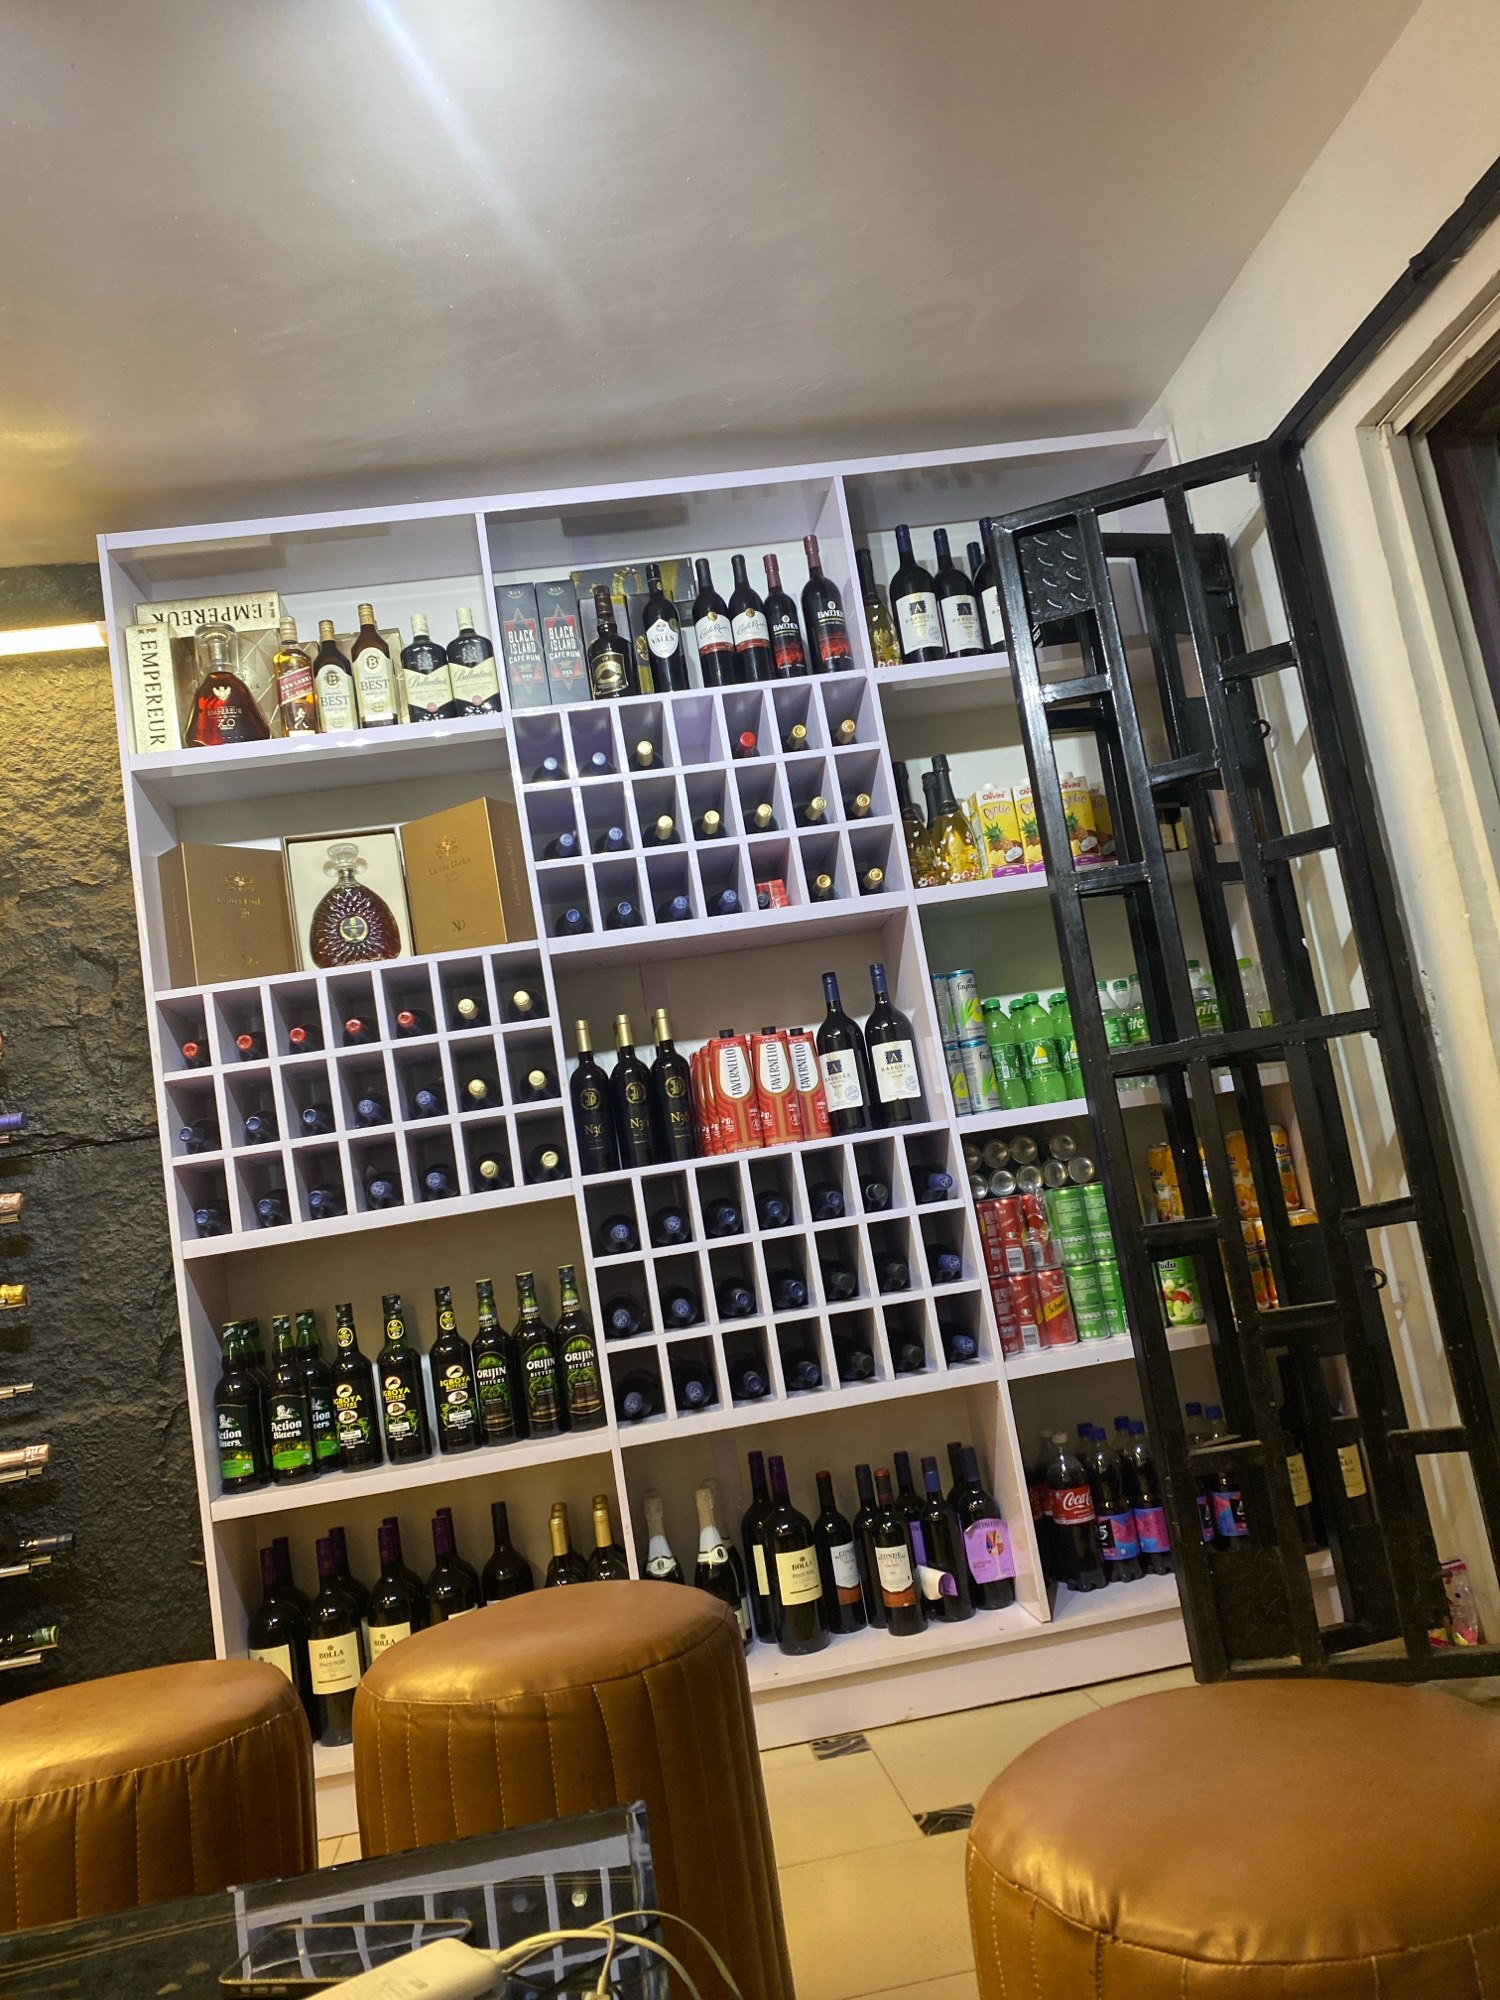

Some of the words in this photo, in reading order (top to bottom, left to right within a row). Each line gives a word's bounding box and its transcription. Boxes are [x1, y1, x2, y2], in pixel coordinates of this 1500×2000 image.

[508, 629, 535, 643] BLACK
[548, 625, 575, 639] BLACK
[509, 641, 537, 655] ISLAND
[550, 638, 577, 651] ISLAND
[360, 679, 390, 691] BEST
[140, 640, 167, 746] EMPEREUR
[320, 695, 350, 707] BEST
[1196, 1001, 1218, 1016] rite
[724, 1048, 743, 1096] TAVERNELLO
[765, 1043, 783, 1091] TAVERNELLO
[794, 1043, 812, 1090] TAVERNELLO
[564, 1349, 595, 1363] ORIJIN
[526, 1357, 556, 1371] ORIJIN
[568, 1361, 594, 1370] BITTERS
[477, 1366, 507, 1379] ORIJIN
[530, 1368, 555, 1378] BITTERS
[440, 1375, 471, 1387] IGBOYA
[480, 1378, 505, 1386] BITTERS
[312, 1410, 331, 1422] tion
[271, 1420, 302, 1432] Action
[313, 1421, 330, 1429] ters
[273, 1430, 301, 1440] Bitters
[791, 1561, 813, 1571] BOLLA
[374, 1638, 397, 1647] BOLLA
[319, 1649, 344, 1660] BOLLA
